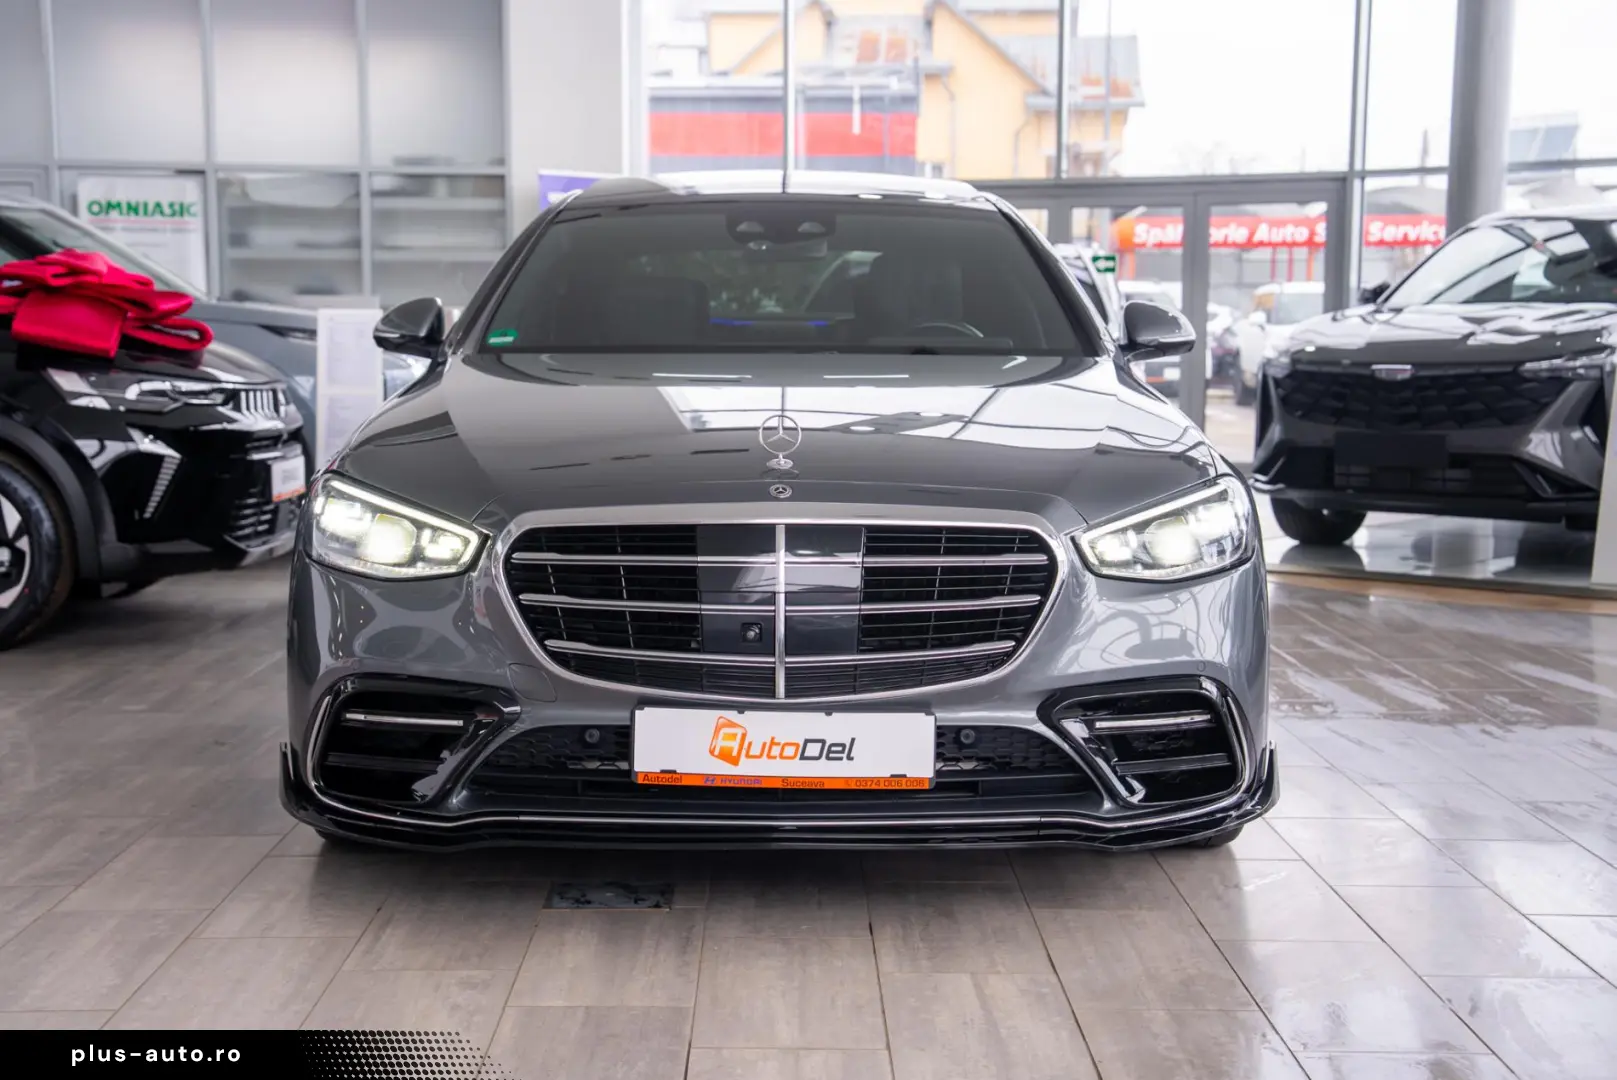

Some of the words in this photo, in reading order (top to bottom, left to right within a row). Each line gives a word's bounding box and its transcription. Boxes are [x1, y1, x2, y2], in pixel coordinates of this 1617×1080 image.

[1252, 222, 1310, 244] Auto
[710, 718, 856, 766] AutoDel
[642, 773, 683, 784] Autodel
[781, 778, 825, 788] Suceava
[855, 779, 881, 788] 0374
[883, 779, 903, 788] 006
[905, 779, 925, 788] 006
